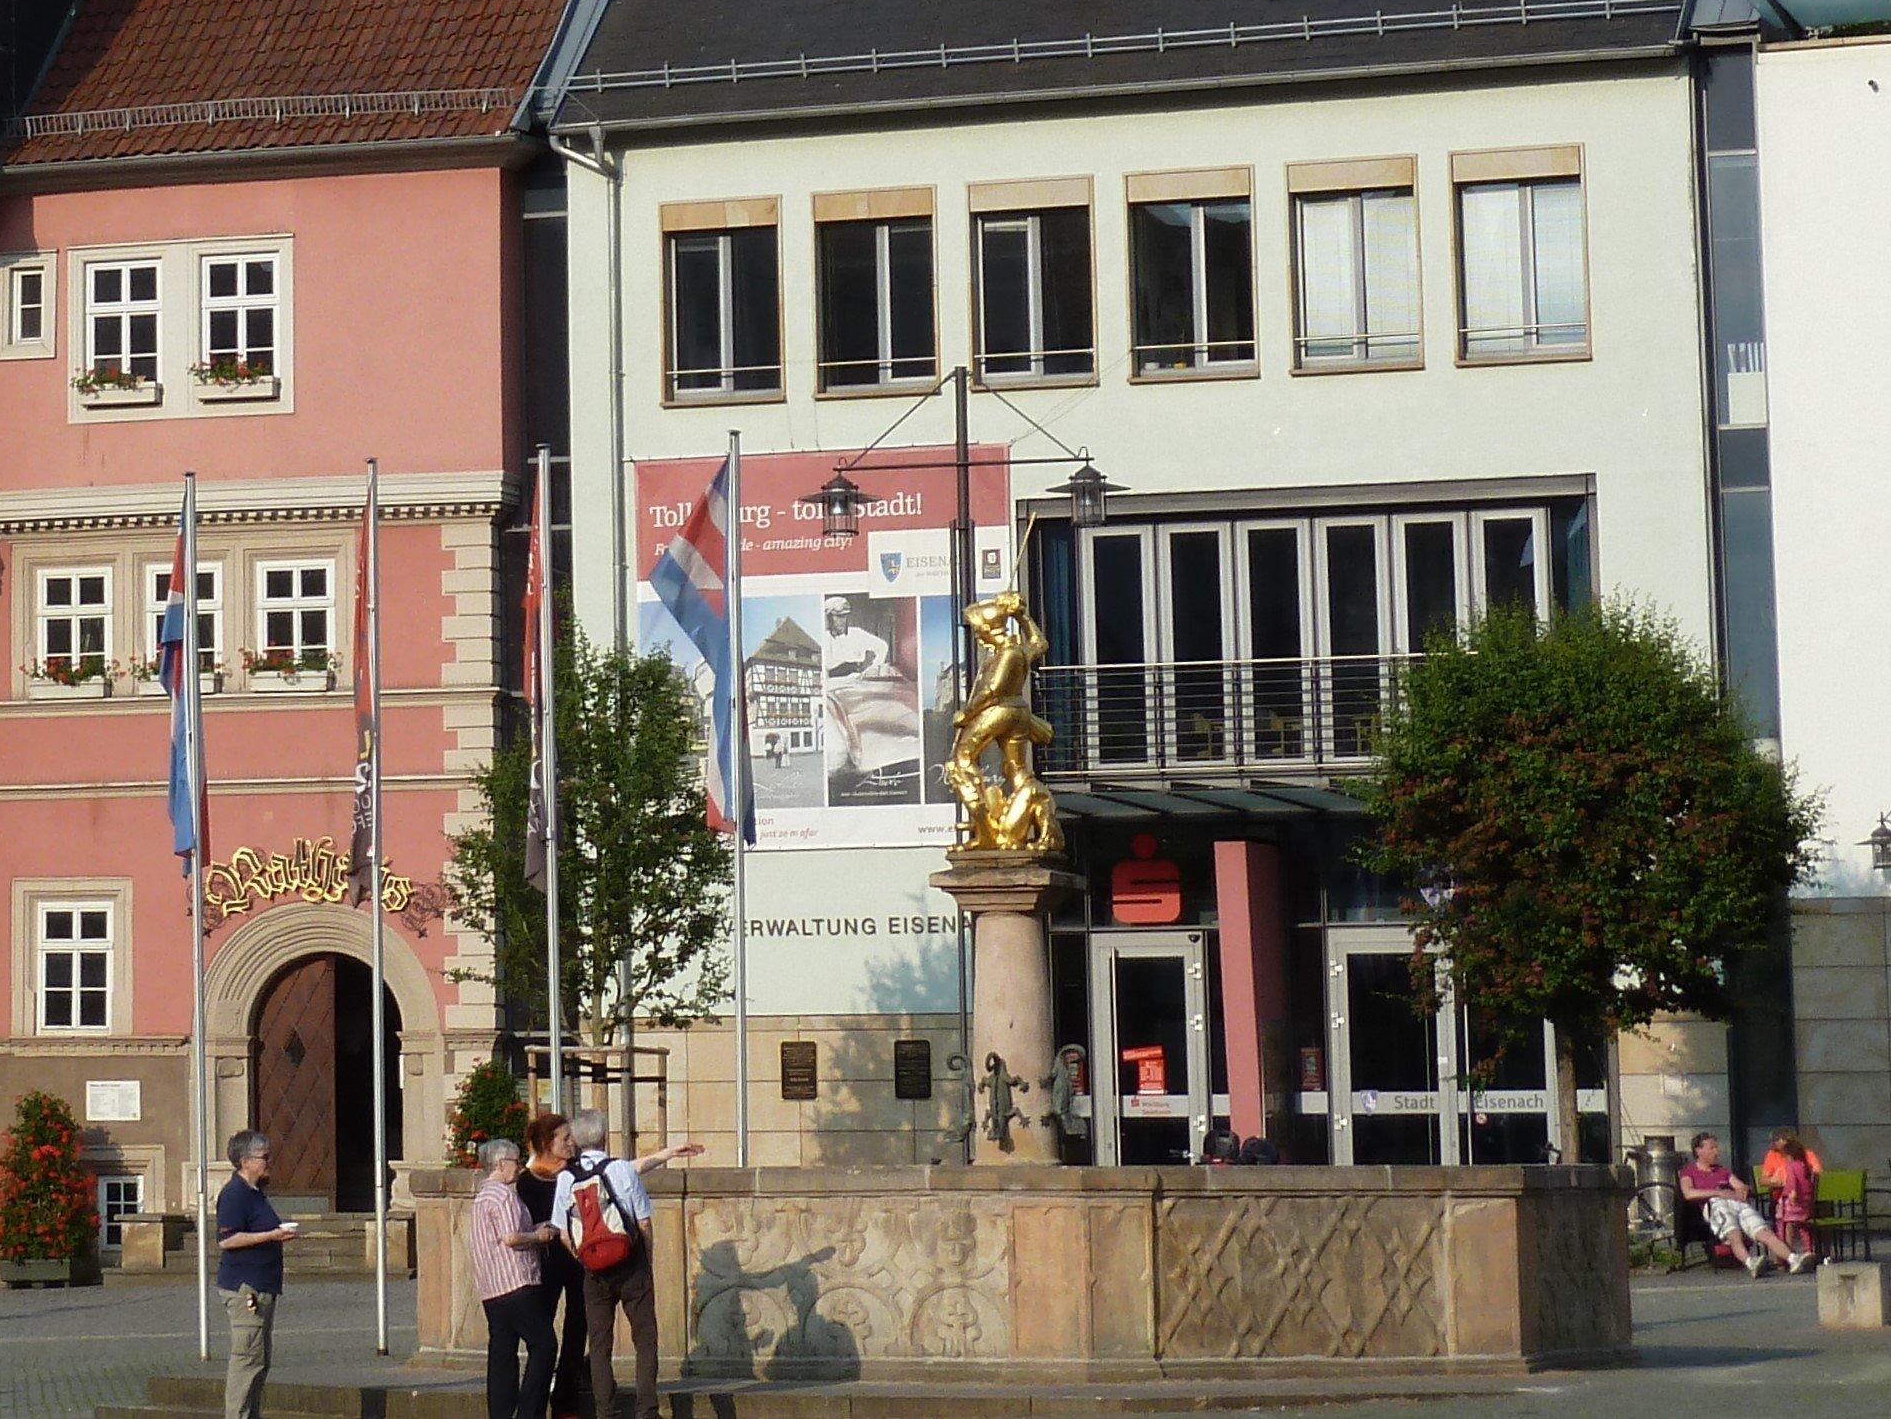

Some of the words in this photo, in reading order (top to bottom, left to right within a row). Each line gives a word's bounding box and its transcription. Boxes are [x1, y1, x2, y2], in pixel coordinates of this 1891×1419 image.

[649, 502, 692, 528] Toll
[762, 536, 822, 552] amazing
[906, 555, 950, 569] EISEN
[1394, 1094, 1435, 1110] Stadt
[1475, 1093, 1544, 1110] Eisenach
